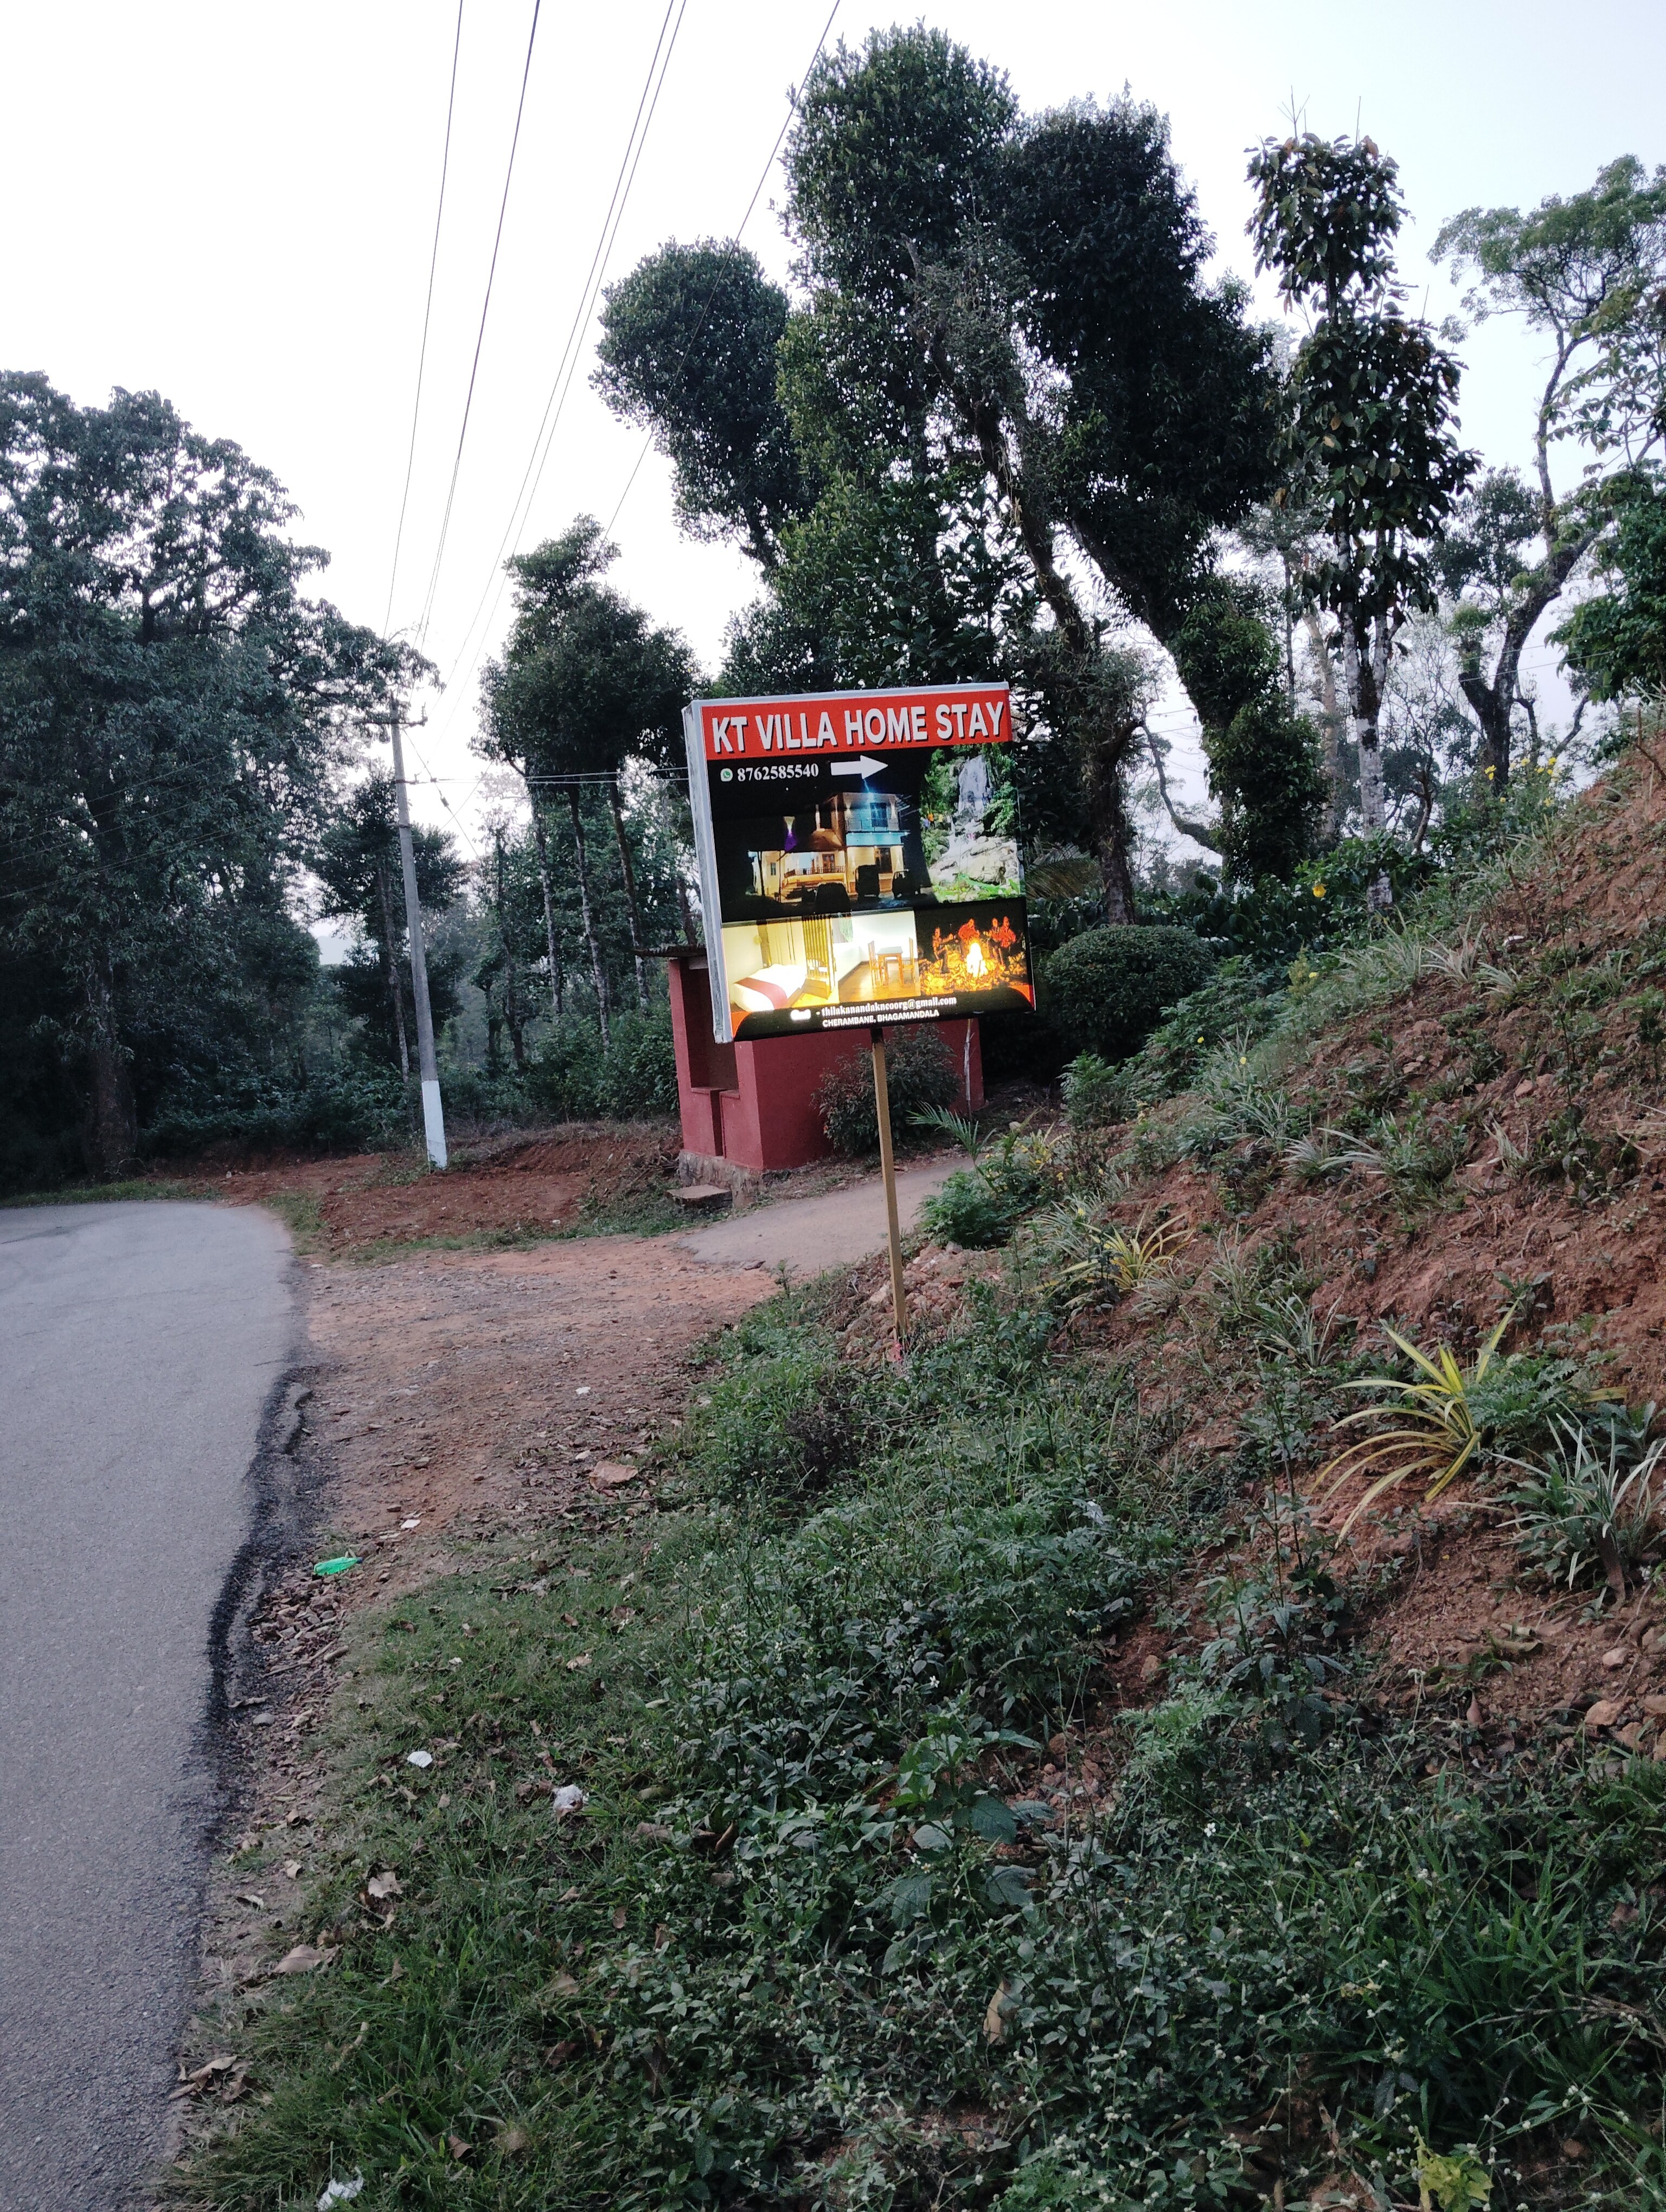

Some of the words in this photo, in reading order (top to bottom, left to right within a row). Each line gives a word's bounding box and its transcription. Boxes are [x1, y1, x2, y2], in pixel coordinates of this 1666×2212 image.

[712, 716, 748, 754] KT
[756, 711, 838, 750] VILLA
[844, 706, 928, 745] HOME
[935, 702, 1003, 740] STAY
[738, 763, 819, 782] 8762585540
[823, 1015, 876, 1027] CHERAMBANE,
[877, 1009, 939, 1022] BHAGAMANDALA
